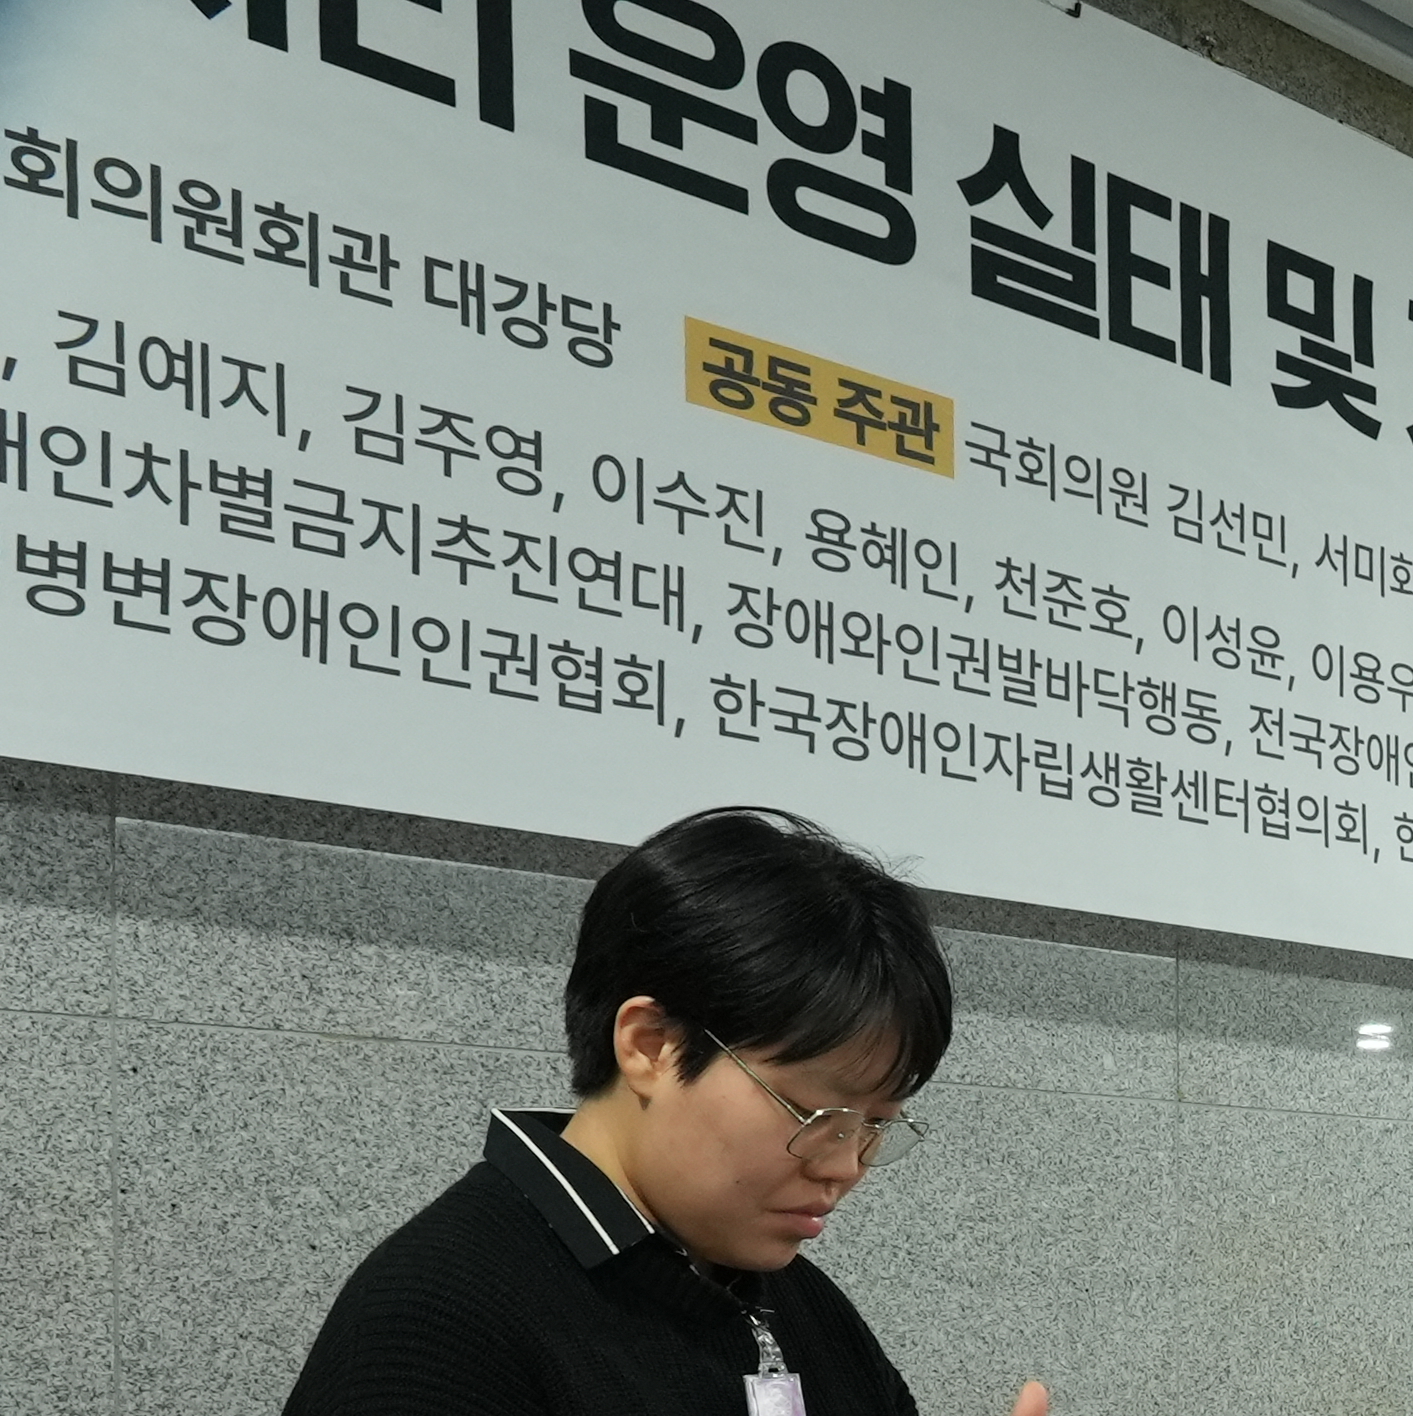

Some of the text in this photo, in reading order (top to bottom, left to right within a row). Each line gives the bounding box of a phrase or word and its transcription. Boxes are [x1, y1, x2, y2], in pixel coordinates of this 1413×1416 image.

[3, 126, 621, 368] 회의원회관 대강당
[568, 0, 917, 266] 운영
[957, 124, 1231, 387] 실태
[1267, 239, 1382, 440] 및
[54, 310, 311, 452] 김예지,
[342, 385, 565, 513] 김주영,
[592, 454, 782, 566] 이수진,
[806, 508, 973, 612] 용혜인,
[995, 557, 1144, 654] 천준호,
[1163, 603, 1295, 690] 이성윤,
[702, 337, 940, 466] 공동 주관
[965, 420, 1148, 527] 국회의원
[1166, 482, 1299, 578] 김선민,
[15, 533, 686, 738] 병변장애인인권협회,
[708, 672, 1379, 864] 한국장애인자립생활센터협의회,
[727, 581, 1231, 756] 장애와인권발바닥행동,
